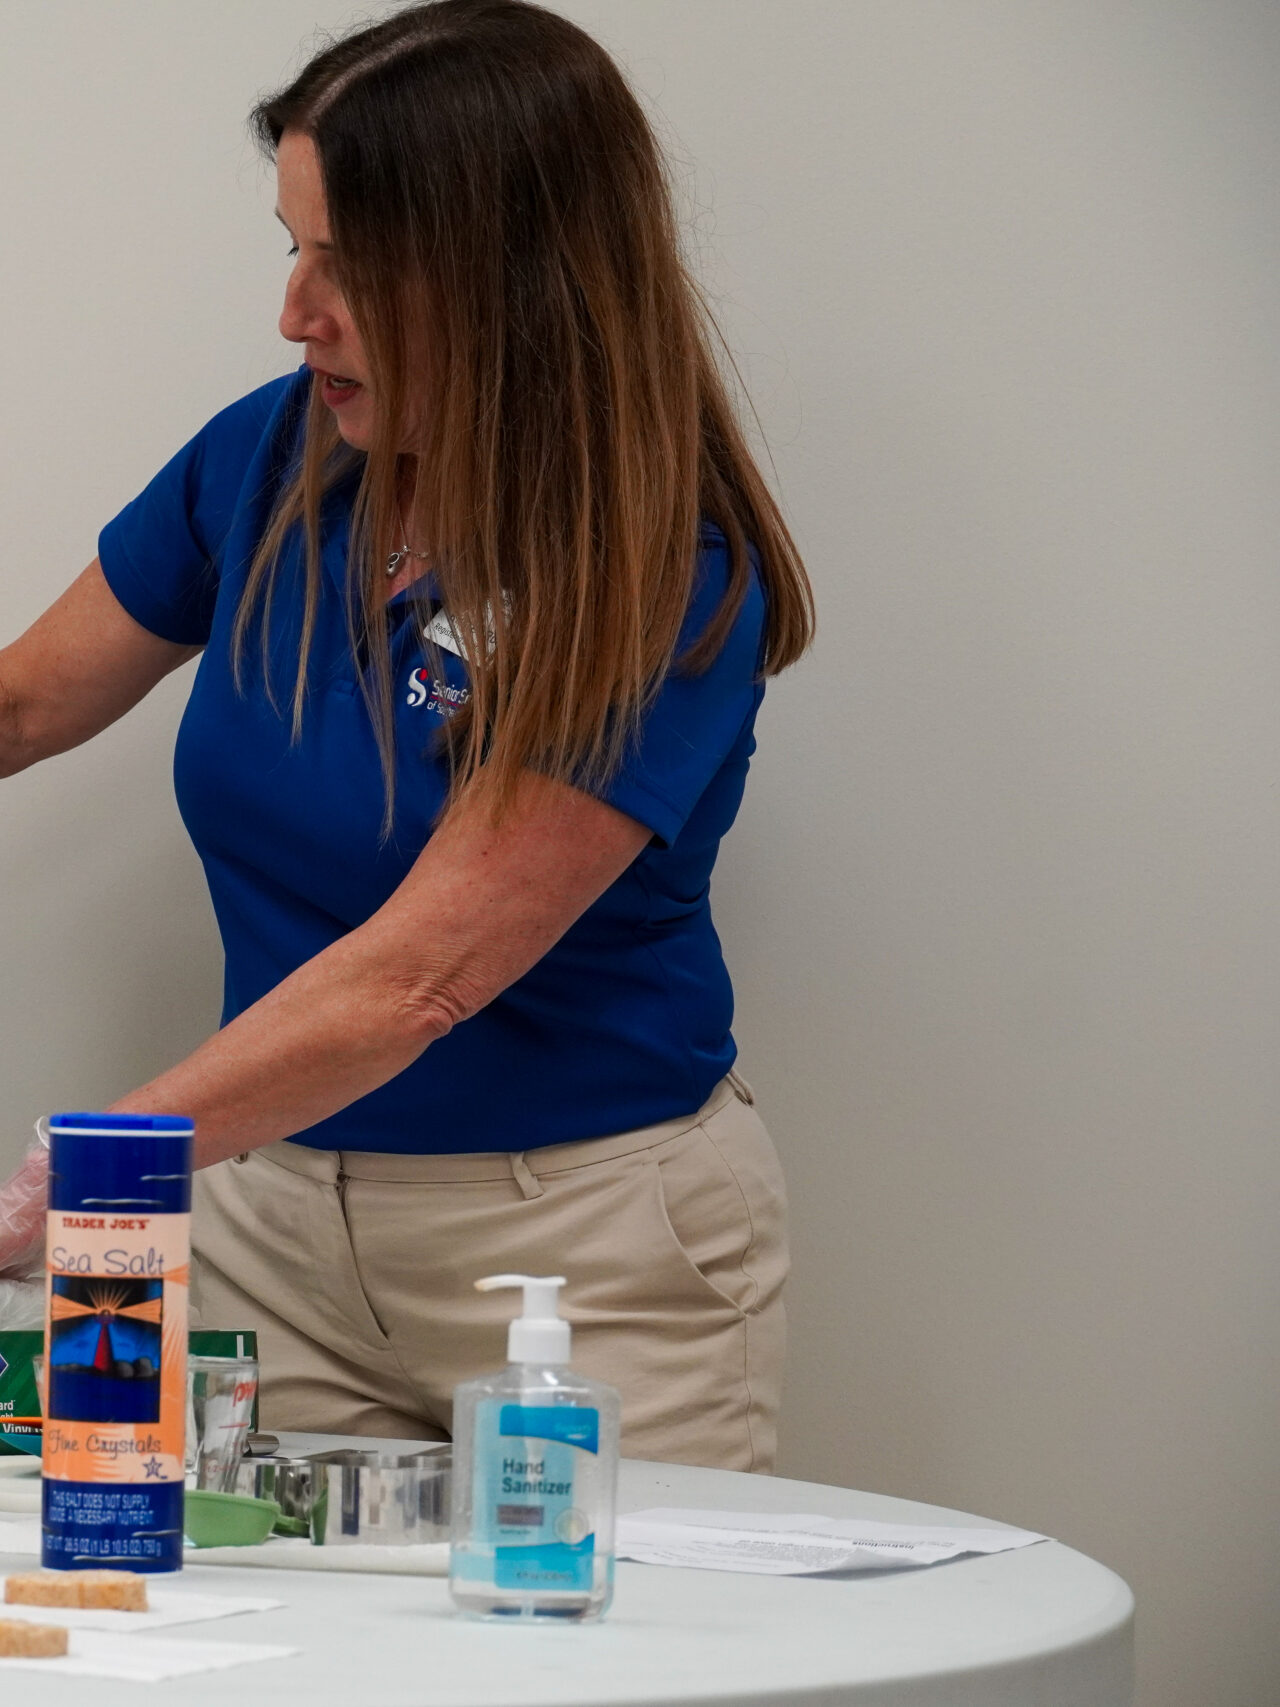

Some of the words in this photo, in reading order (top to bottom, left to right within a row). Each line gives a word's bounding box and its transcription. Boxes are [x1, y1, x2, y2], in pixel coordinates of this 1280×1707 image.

[62, 1217, 105, 1229] TRADER
[109, 1219, 147, 1230] JOE'S
[52, 1246, 92, 1274] Sea
[103, 1247, 164, 1276] Salt
[47, 1429, 80, 1454] Fine
[86, 1433, 162, 1461] Crystals
[503, 1458, 545, 1475] Hand
[501, 1476, 572, 1496] Sanitizer
[65, 1491, 81, 1508] SALT
[82, 1492, 103, 1509] DOES
[104, 1493, 120, 1509] NOT
[121, 1494, 150, 1510] SUPPLY
[74, 1509, 117, 1525] NECESSARY
[79, 1538, 90, 1554] OZ
[99, 1539, 110, 1554] LB
